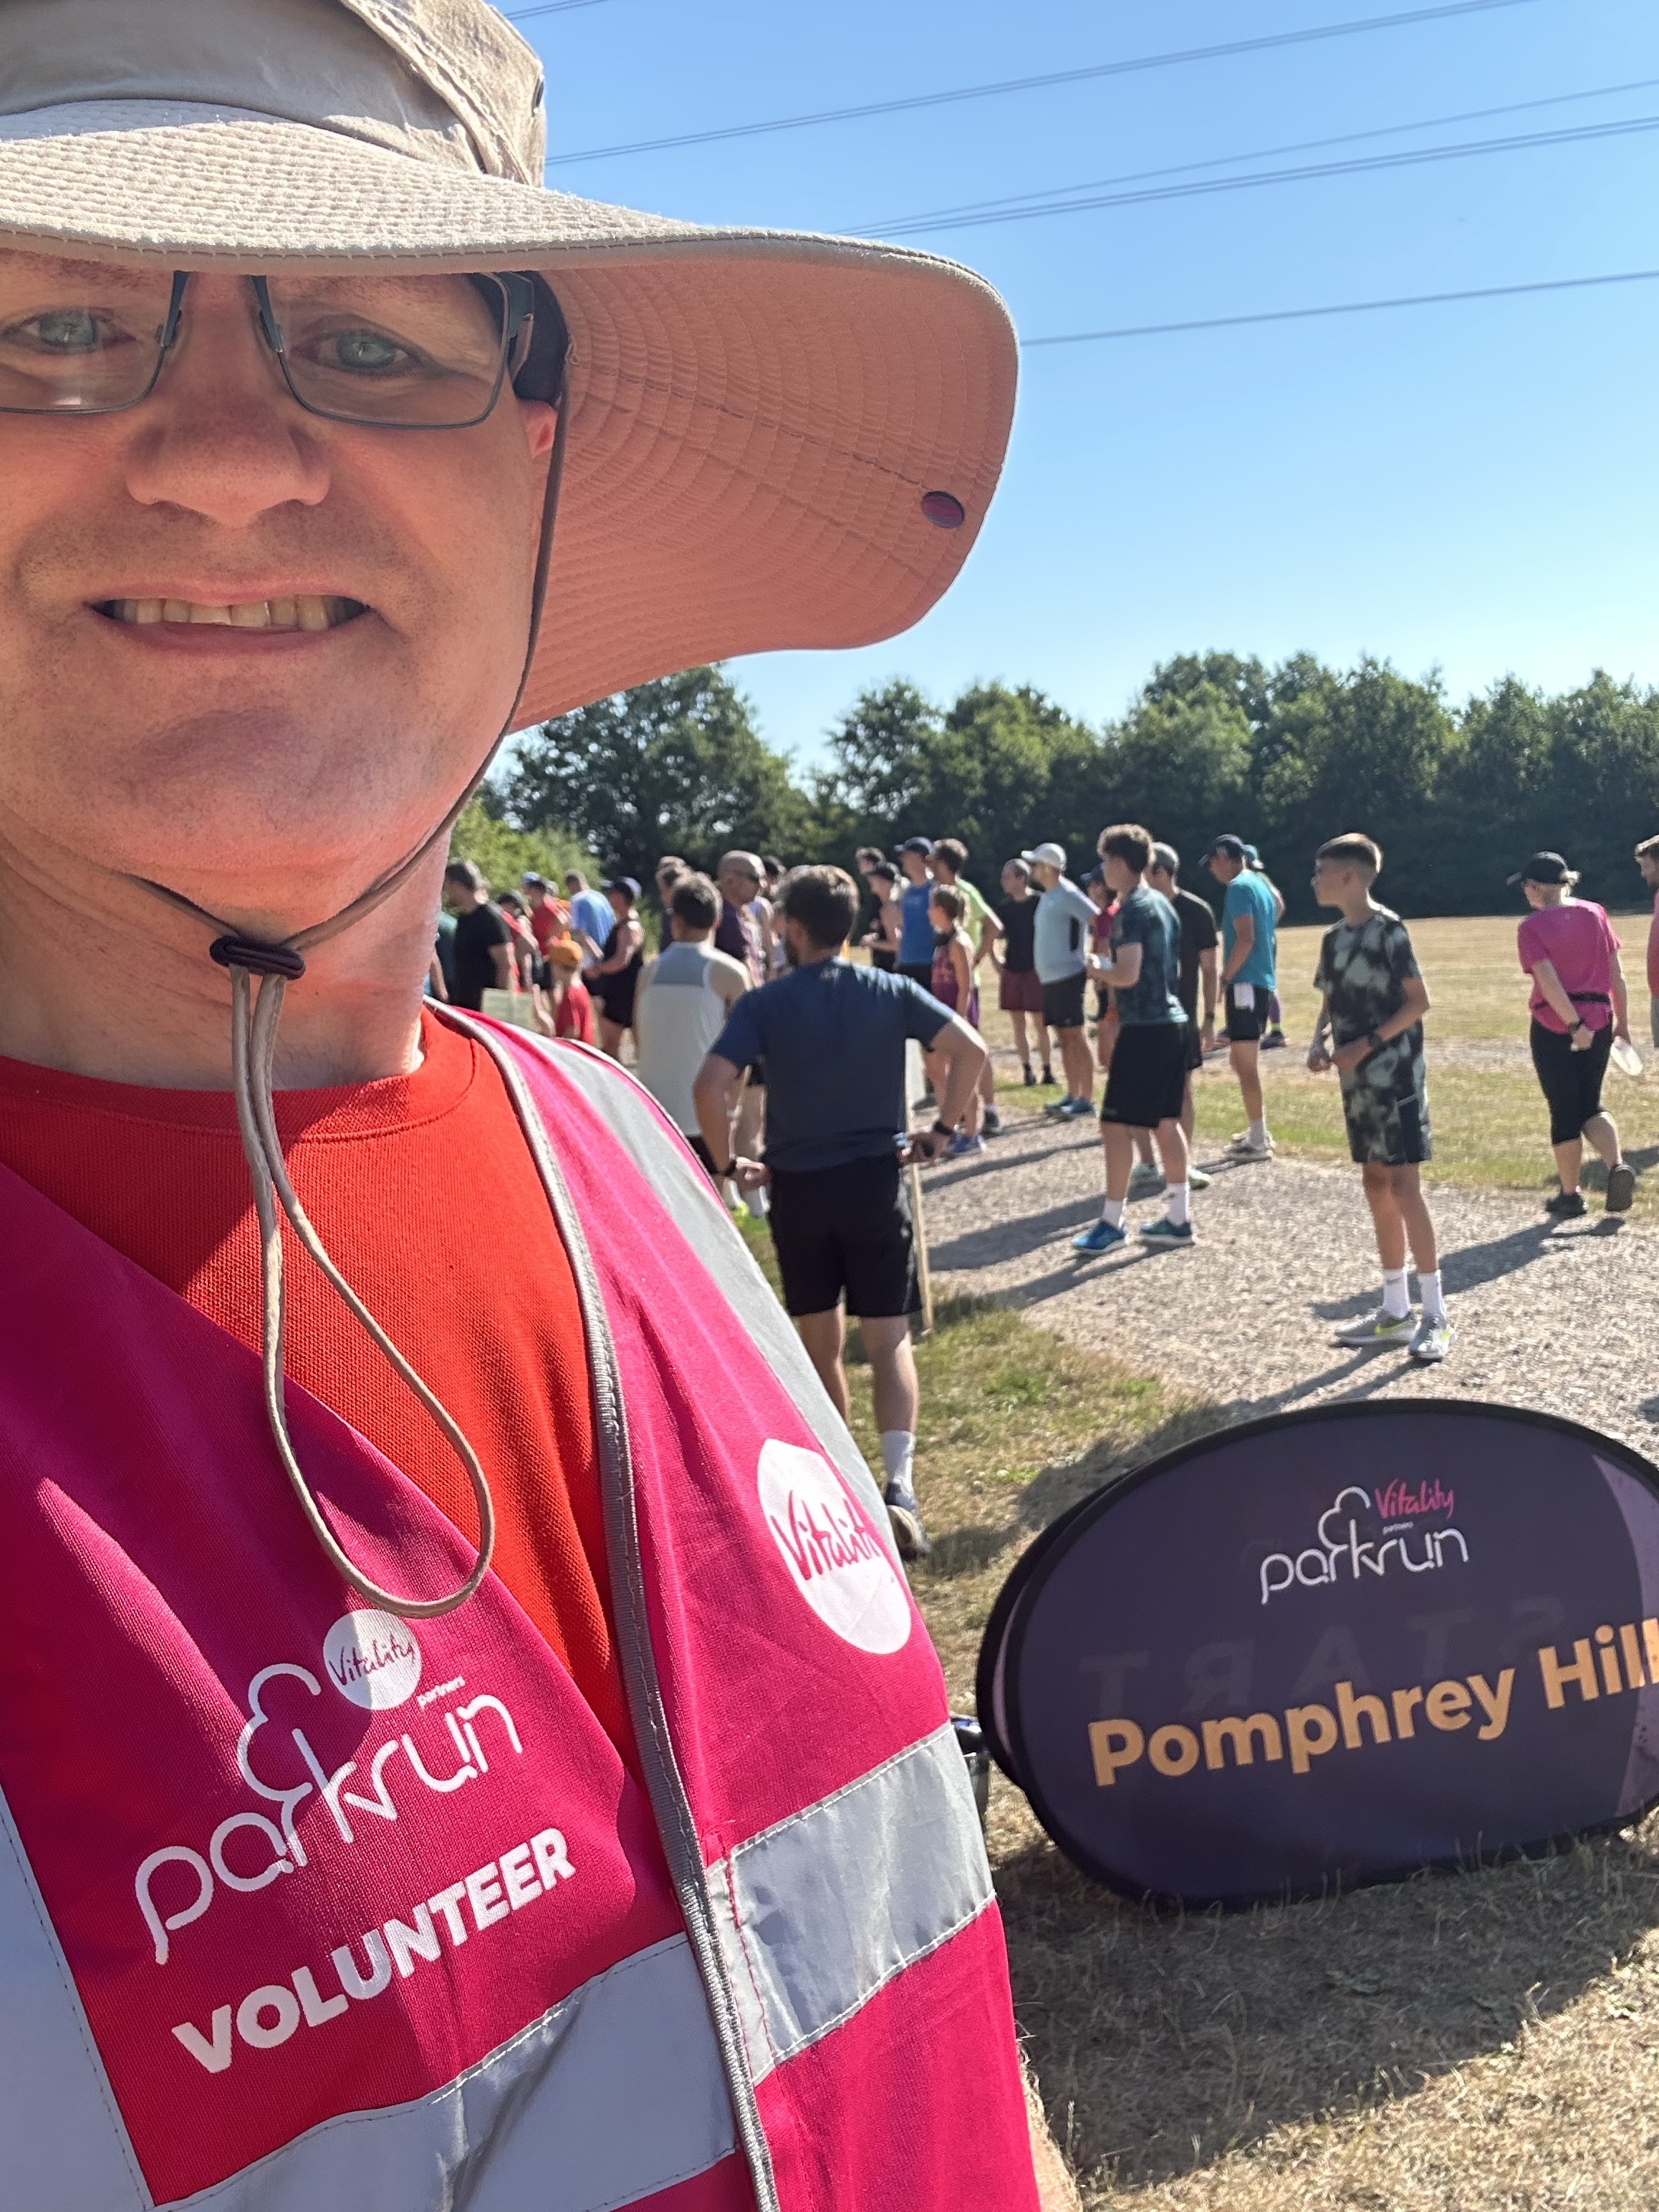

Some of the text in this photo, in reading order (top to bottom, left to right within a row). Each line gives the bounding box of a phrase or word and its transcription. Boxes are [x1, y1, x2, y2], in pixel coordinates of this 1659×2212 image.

[1259, 1517, 1469, 1606] parkrun
[1374, 1477, 1455, 1520] Vitality
[328, 1632, 416, 1686] Vitality
[1087, 1617, 1659, 1787] Pomphrey Hill
[134, 1693, 524, 1966] parkrun
[170, 1827, 577, 2074] VOLUNTEER
